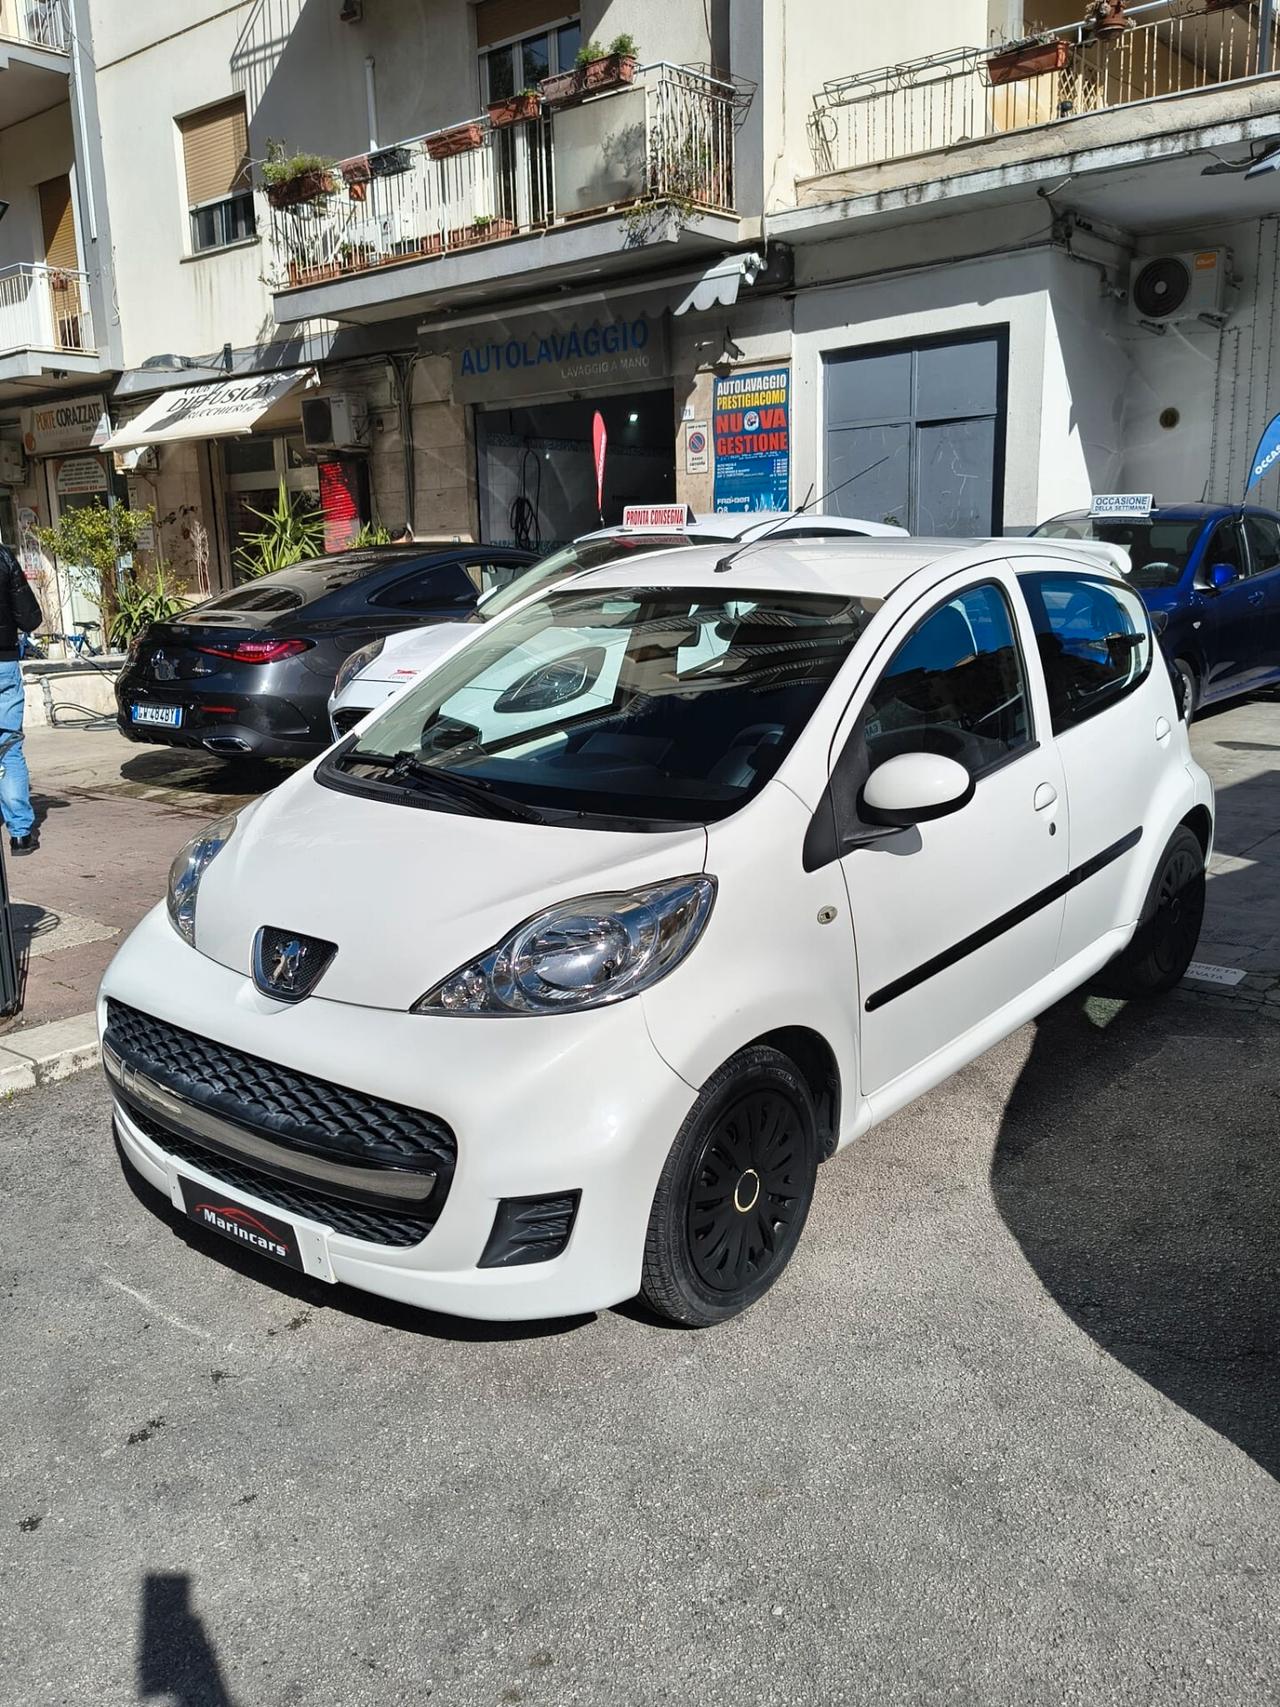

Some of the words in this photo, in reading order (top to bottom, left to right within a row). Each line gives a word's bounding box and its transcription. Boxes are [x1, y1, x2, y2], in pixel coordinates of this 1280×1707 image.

[461, 319, 649, 376] AUTOLAVAGGIO
[561, 361, 609, 379] LAVAGGIO
[611, 360, 618, 370] A
[620, 354, 650, 370] MANO
[717, 374, 786, 396] AUTOLAVAGGIO
[717, 389, 786, 411] PRESTIGIACOMO
[36, 410, 56, 431] PORTE
[56, 403, 101, 427] CORAZZATE
[717, 432, 787, 456] GESTIONE
[1095, 496, 1147, 505] OCCASIONE
[626, 510, 649, 525] PRONTA
[650, 509, 684, 525] CONSEGNA
[204, 1208, 287, 1257] Marincars
